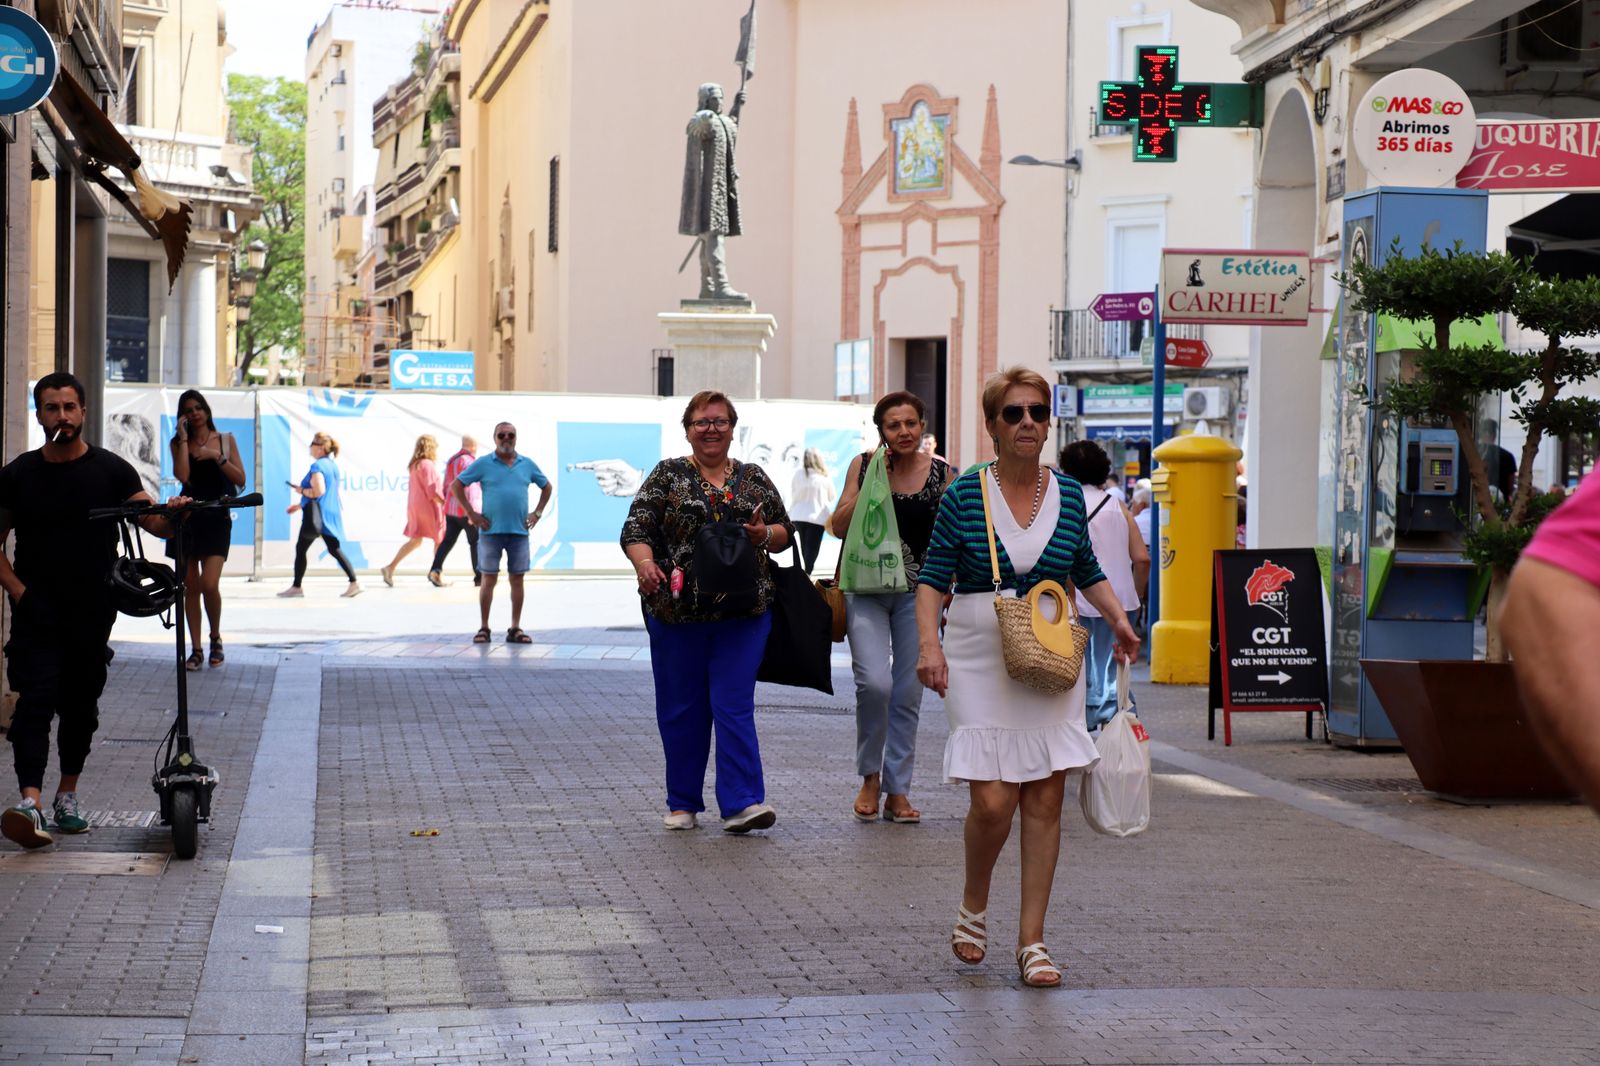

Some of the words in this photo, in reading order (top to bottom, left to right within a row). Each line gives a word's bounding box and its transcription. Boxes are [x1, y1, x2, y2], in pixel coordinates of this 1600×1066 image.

[1140, 93, 1182, 118] DE
[1387, 96, 1464, 115] MAS&GO
[1382, 120, 1450, 134] Abrimos
[1377, 137, 1409, 152] 365
[1414, 137, 1453, 153] días
[1221, 258, 1298, 276] Estética
[1168, 290, 1284, 314] CARHEL
[1260, 591, 1284, 602] CGT
[1251, 627, 1292, 644] CGT
[1257, 648, 1308, 656] SINDICATO
[1231, 658, 1251, 667] QUE
[1252, 658, 1266, 666] NO
[1267, 658, 1280, 666] SE
